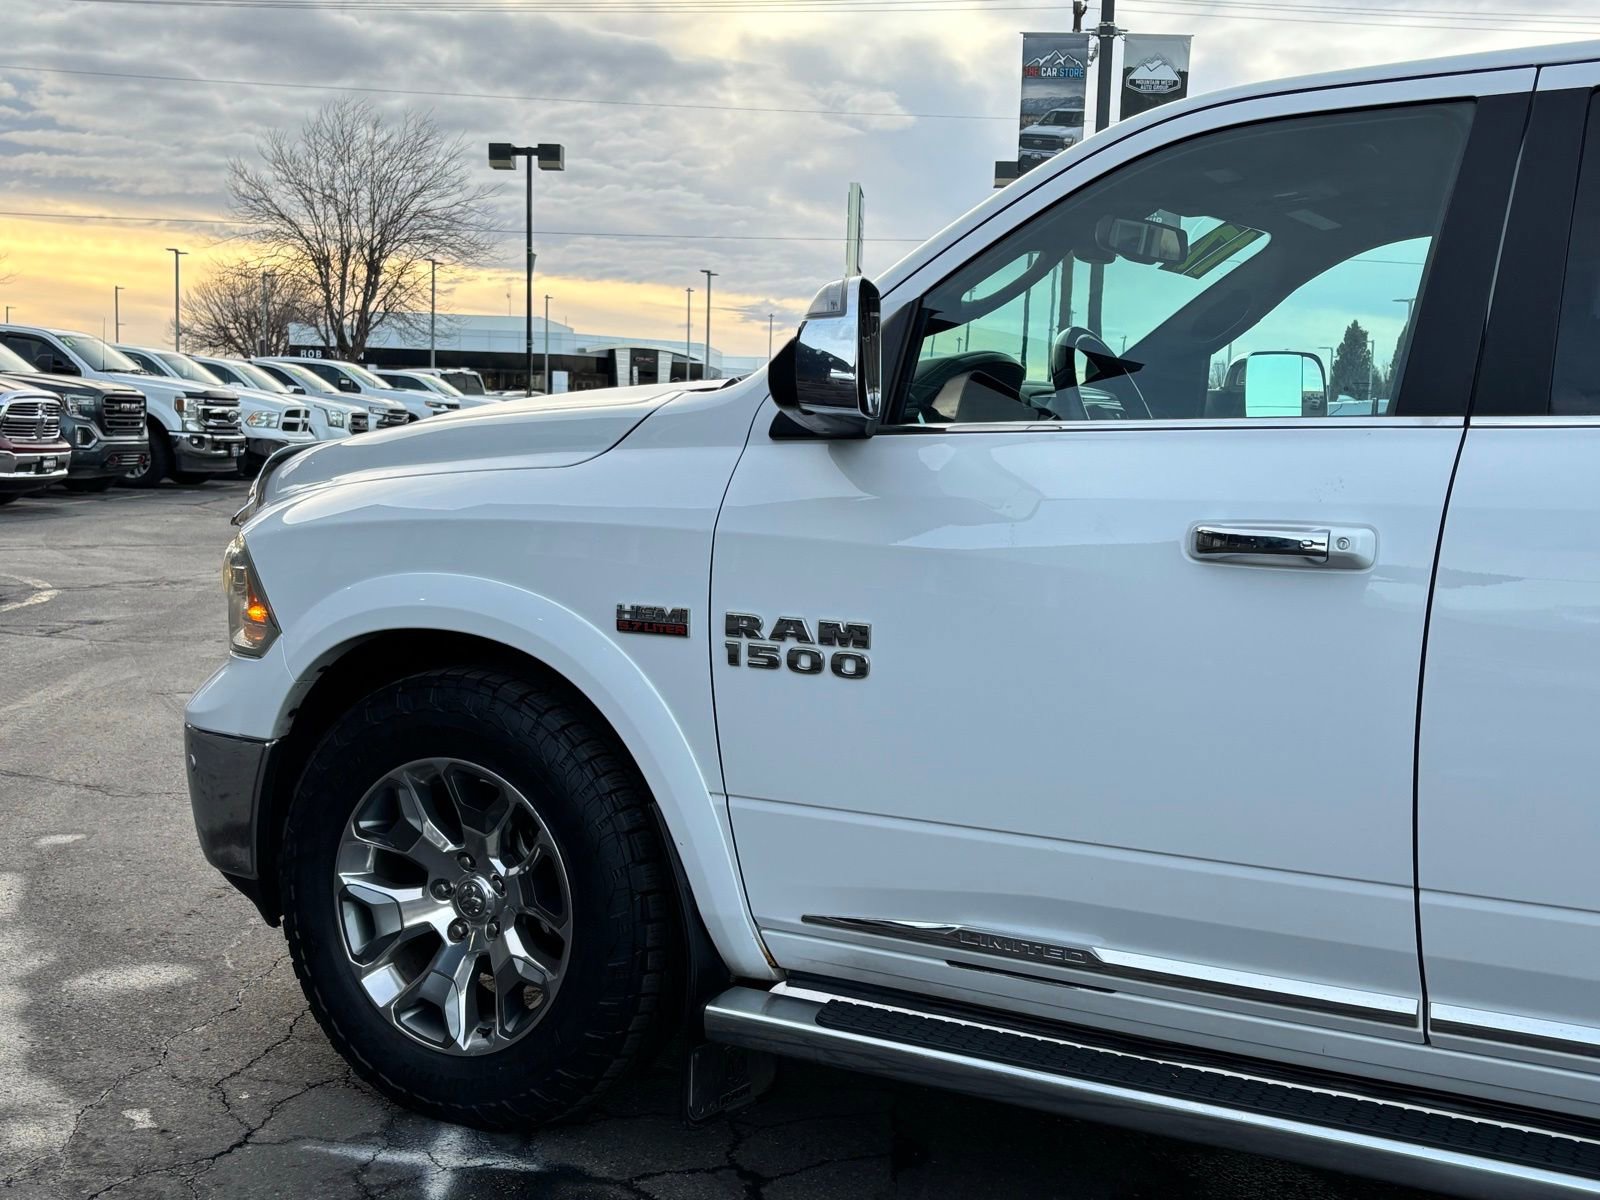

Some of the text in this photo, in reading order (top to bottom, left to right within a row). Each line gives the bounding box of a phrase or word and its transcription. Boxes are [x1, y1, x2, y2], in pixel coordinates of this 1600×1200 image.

[1024, 67, 1084, 77] THE CAR STORE
[616, 603, 690, 624] HEMI
[617, 620, 686, 635] 5.7 LITER
[725, 612, 872, 649] RAM
[725, 640, 871, 679] 1500
[958, 931, 1089, 964] LIMITED
